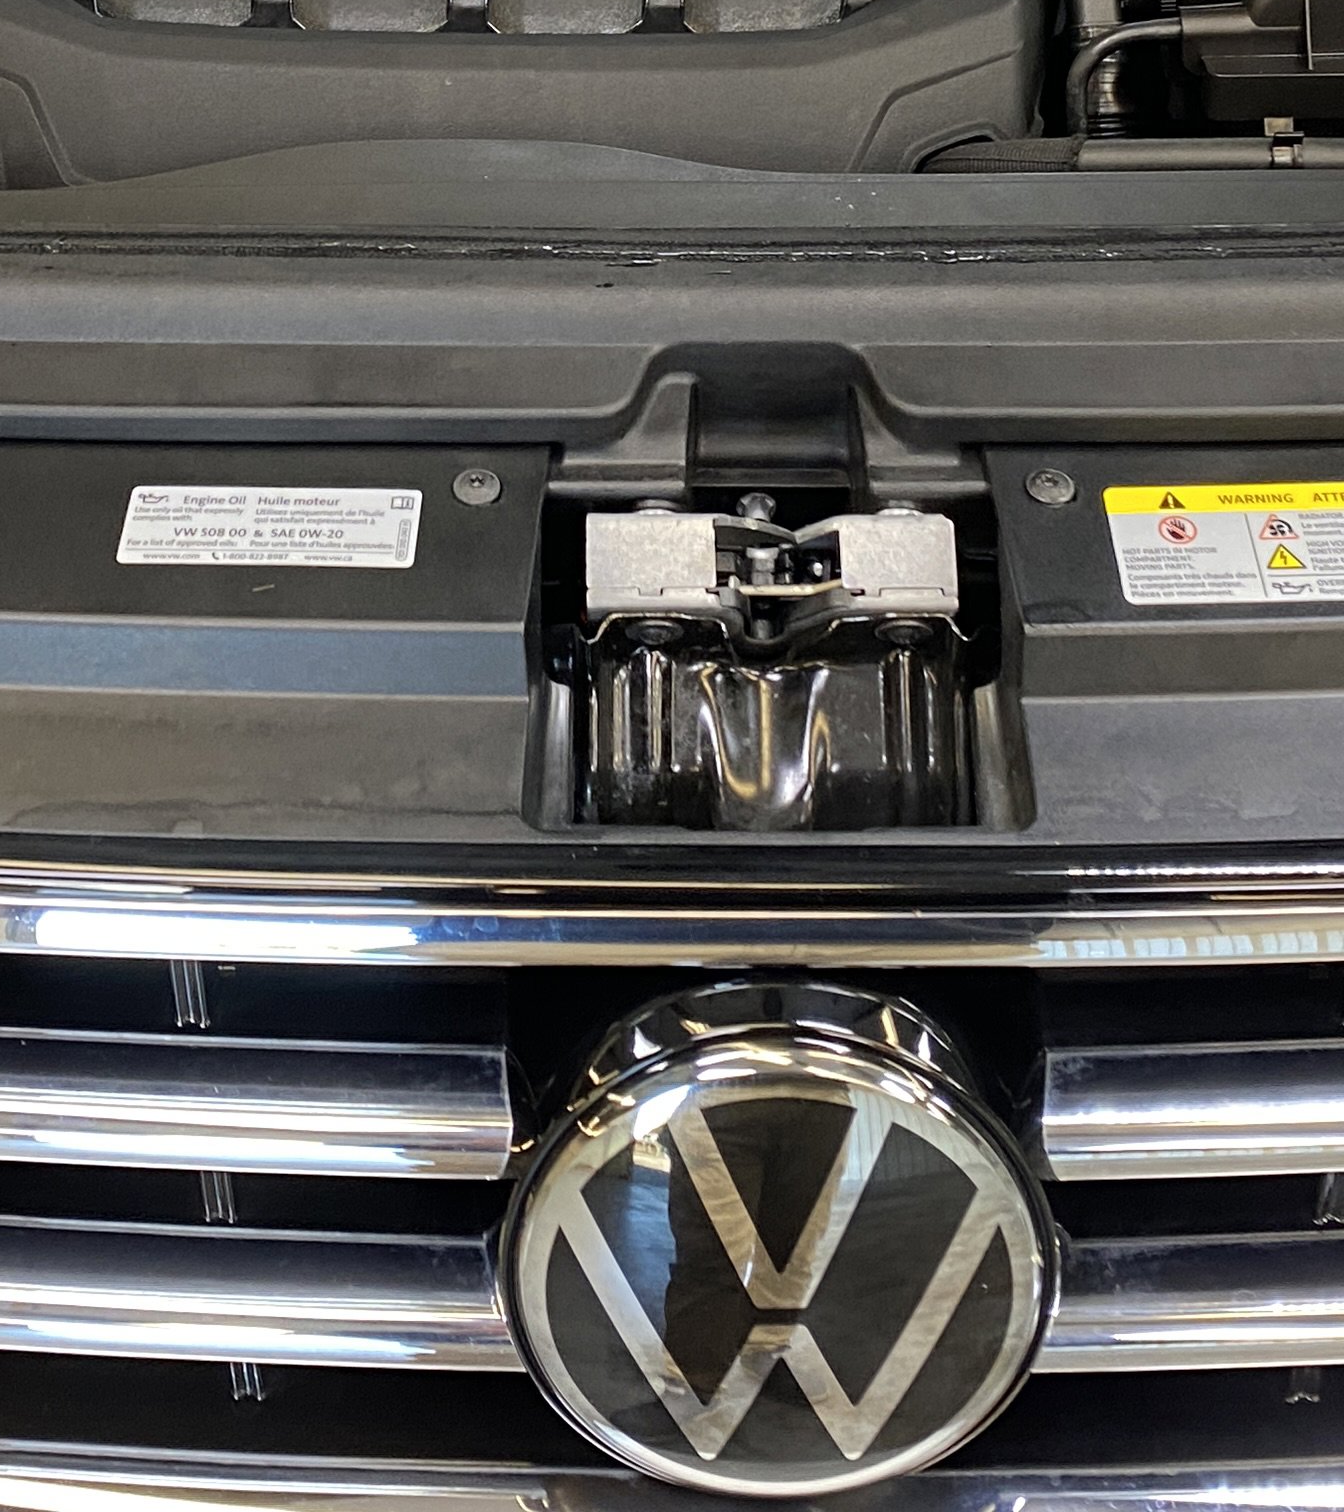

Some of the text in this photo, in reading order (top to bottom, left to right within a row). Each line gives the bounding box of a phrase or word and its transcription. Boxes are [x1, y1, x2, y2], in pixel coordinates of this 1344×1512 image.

[183, 495, 247, 506] Engine Oil
[257, 496, 341, 506] Huile moteur
[1217, 492, 1294, 505] WARNING
[173, 527, 344, 539] VW 508 00 & SAE 0W-20
